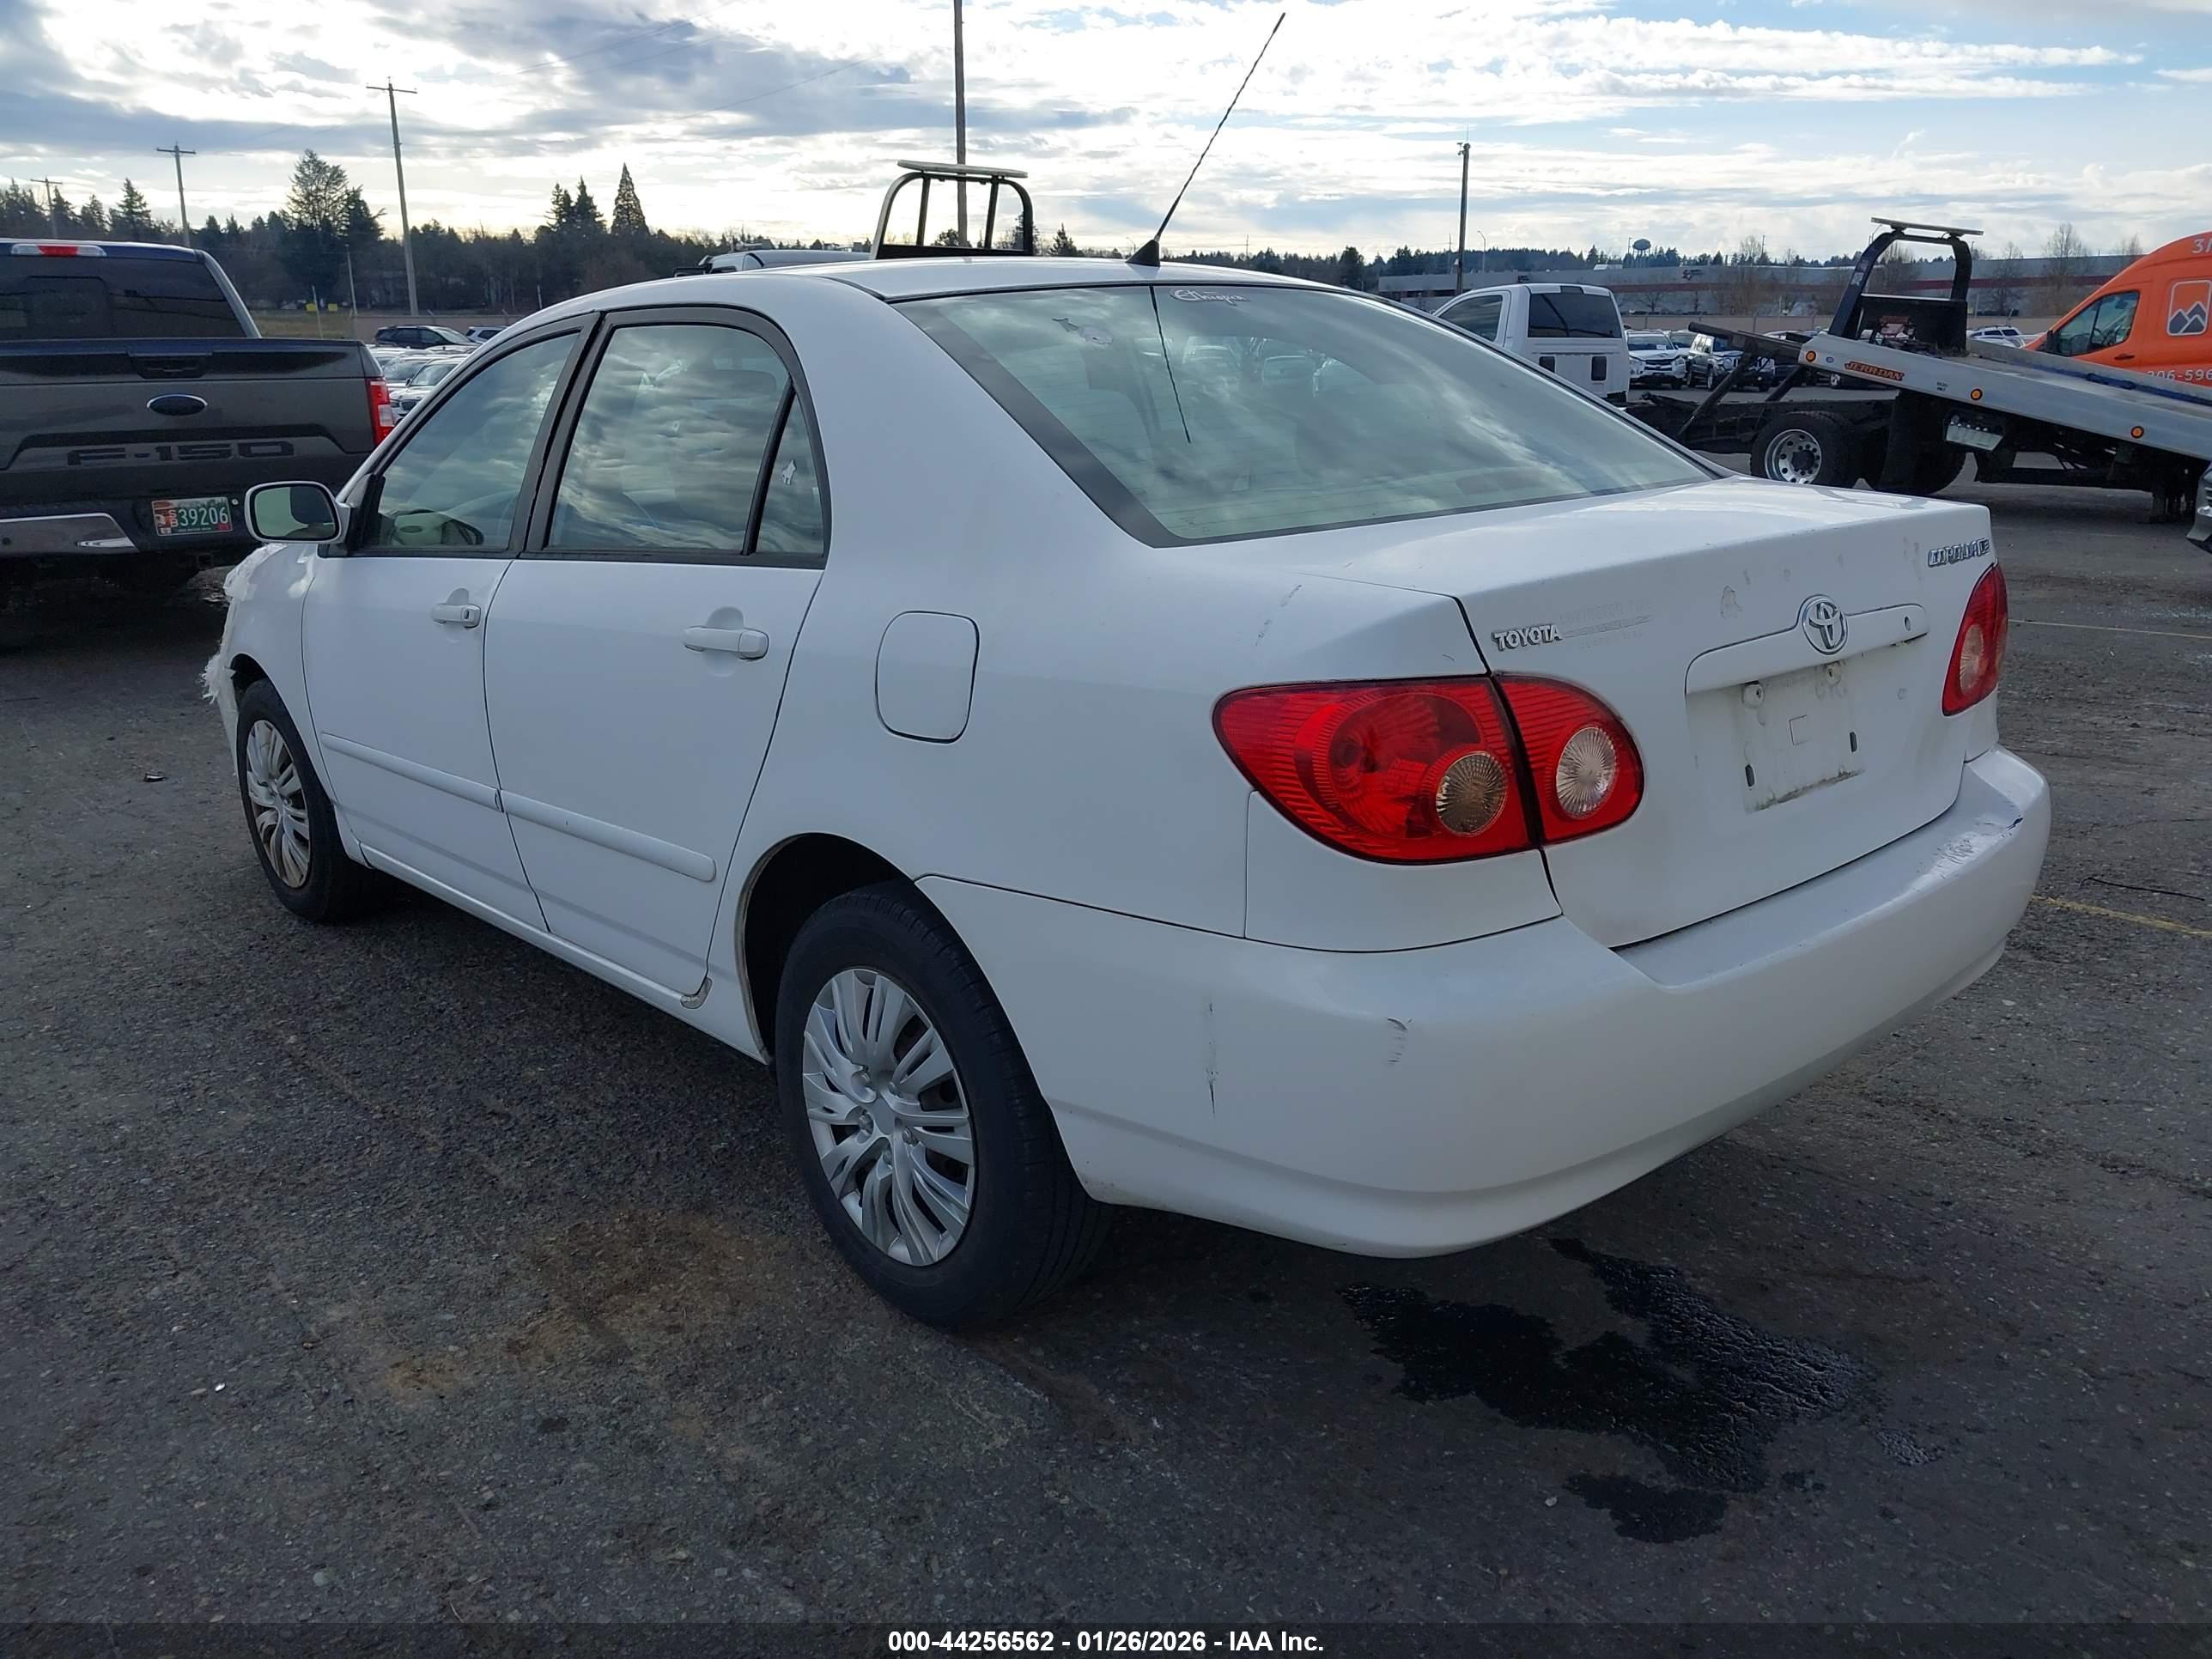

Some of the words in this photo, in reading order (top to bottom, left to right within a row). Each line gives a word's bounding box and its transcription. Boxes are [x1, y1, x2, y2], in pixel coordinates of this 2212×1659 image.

[67, 441, 294, 465] F-150
[179, 507, 228, 526] 39206
[1493, 624, 1562, 651] TOYOTA
